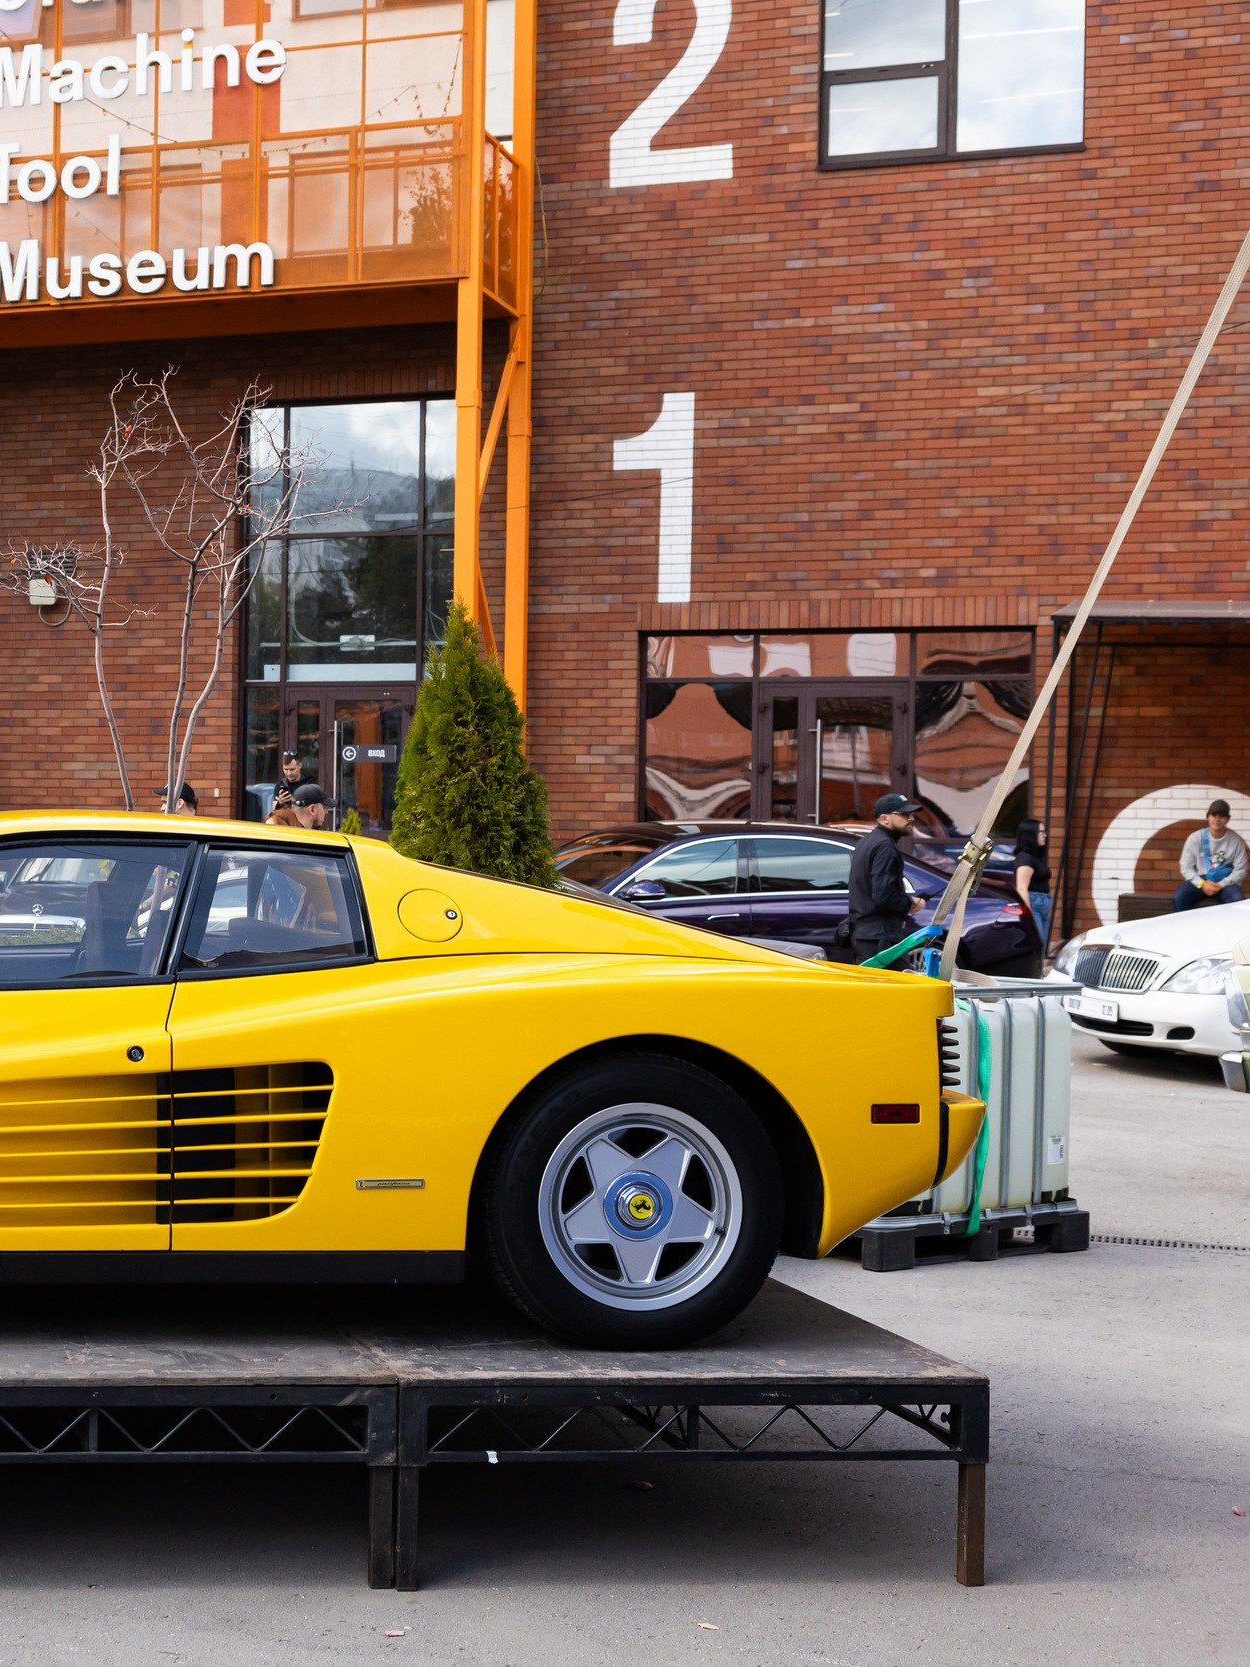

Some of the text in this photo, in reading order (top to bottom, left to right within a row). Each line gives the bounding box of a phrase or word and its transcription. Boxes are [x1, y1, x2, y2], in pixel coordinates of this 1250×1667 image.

[610, 0, 733, 188] 2
[613, 392, 695, 603] 1
[367, 749, 386, 758] ВХОД
